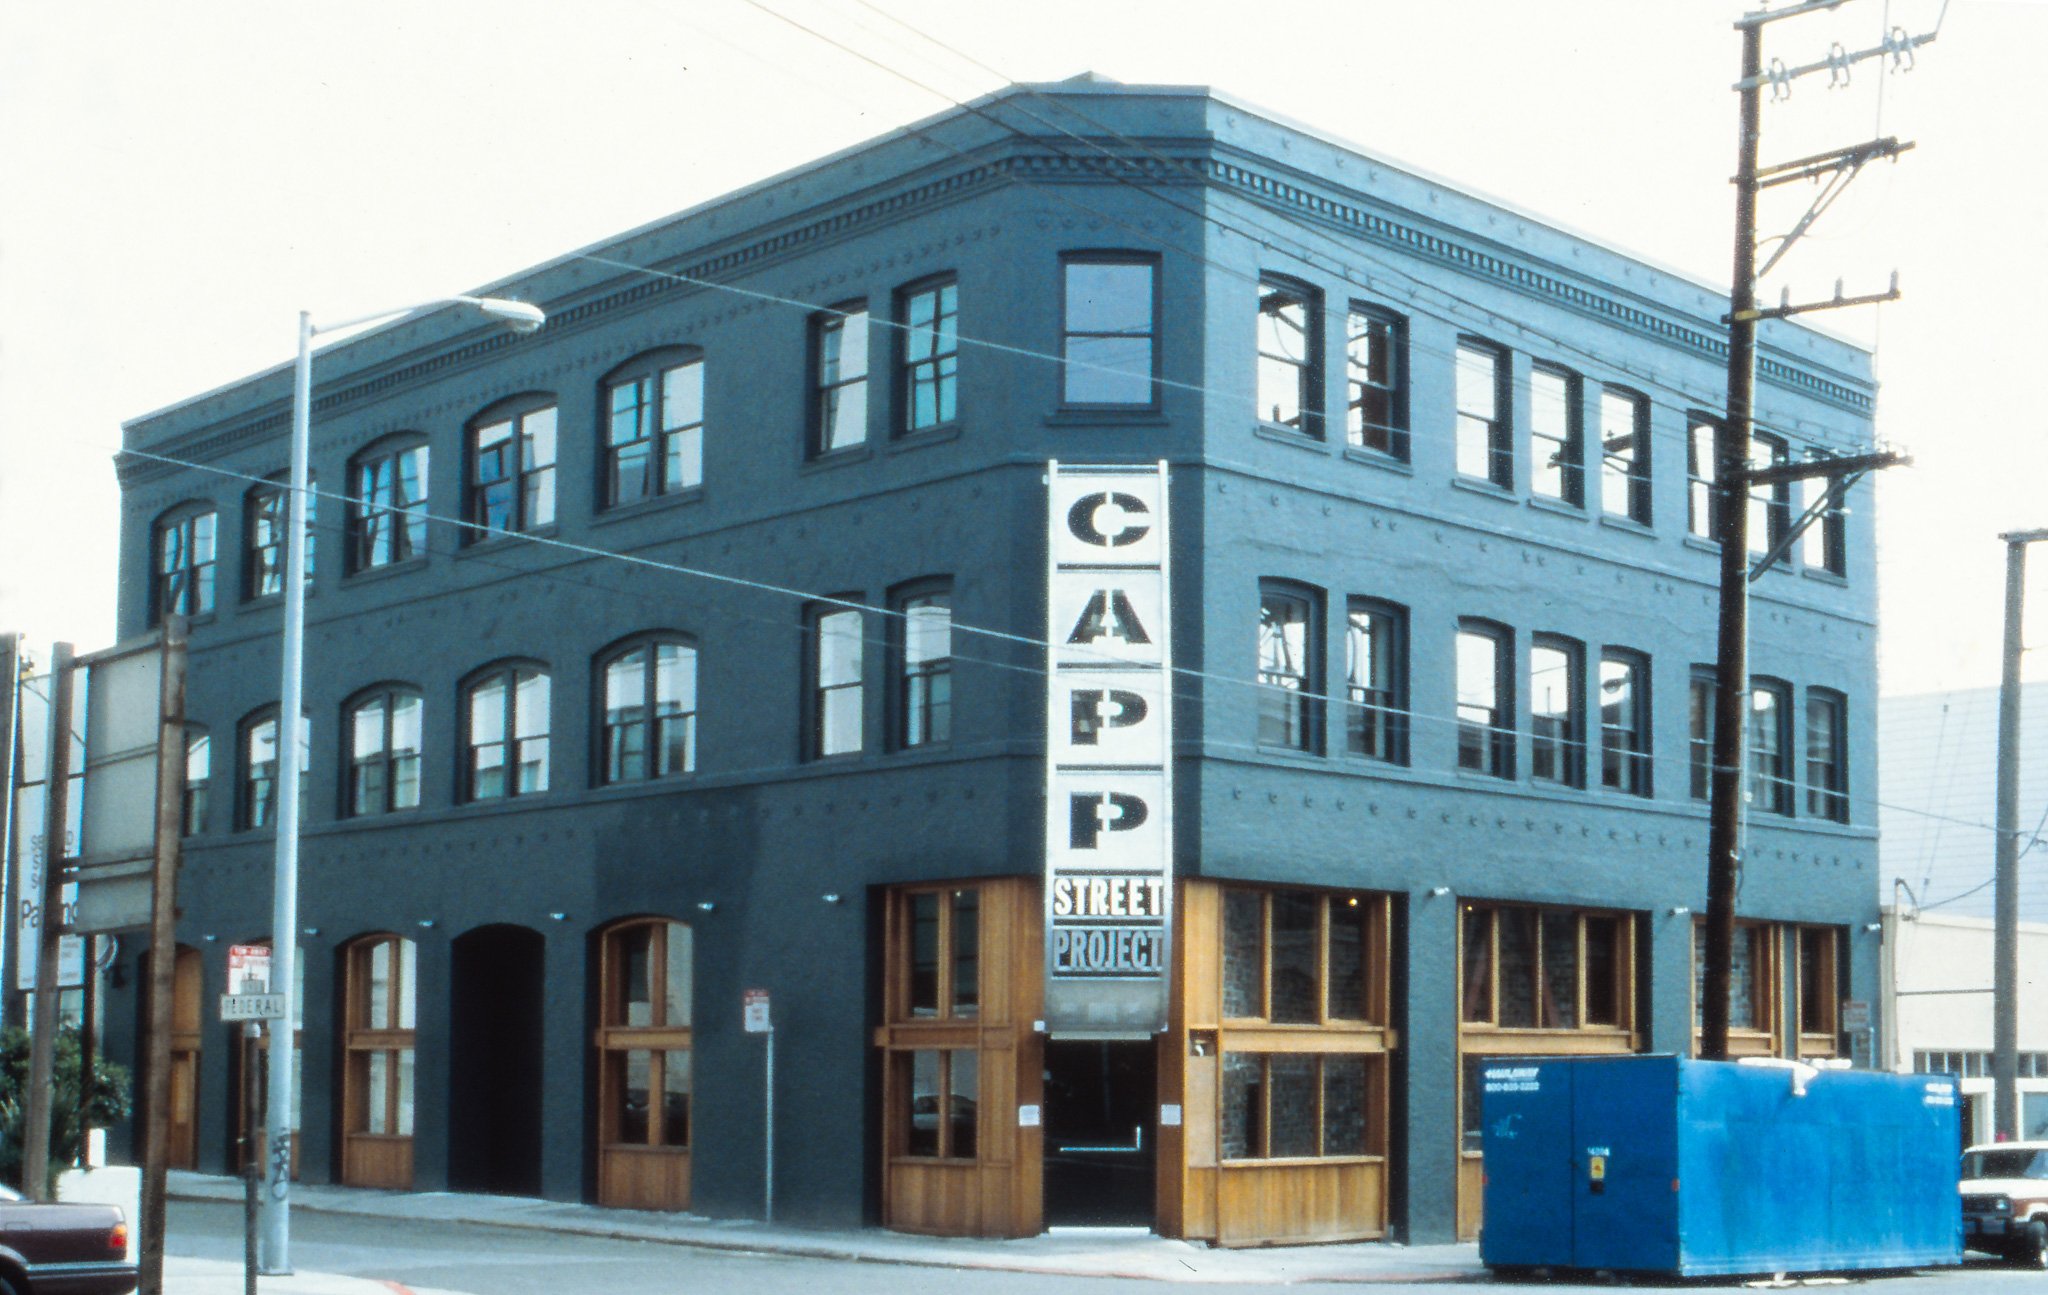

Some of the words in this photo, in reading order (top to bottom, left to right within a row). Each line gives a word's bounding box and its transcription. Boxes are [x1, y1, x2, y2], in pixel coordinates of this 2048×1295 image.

[1066, 491, 1153, 849] CAPP
[1054, 878, 1164, 916] STREET
[1053, 929, 1164, 970] PROJECT
[224, 998, 280, 1015] FEDERAL
